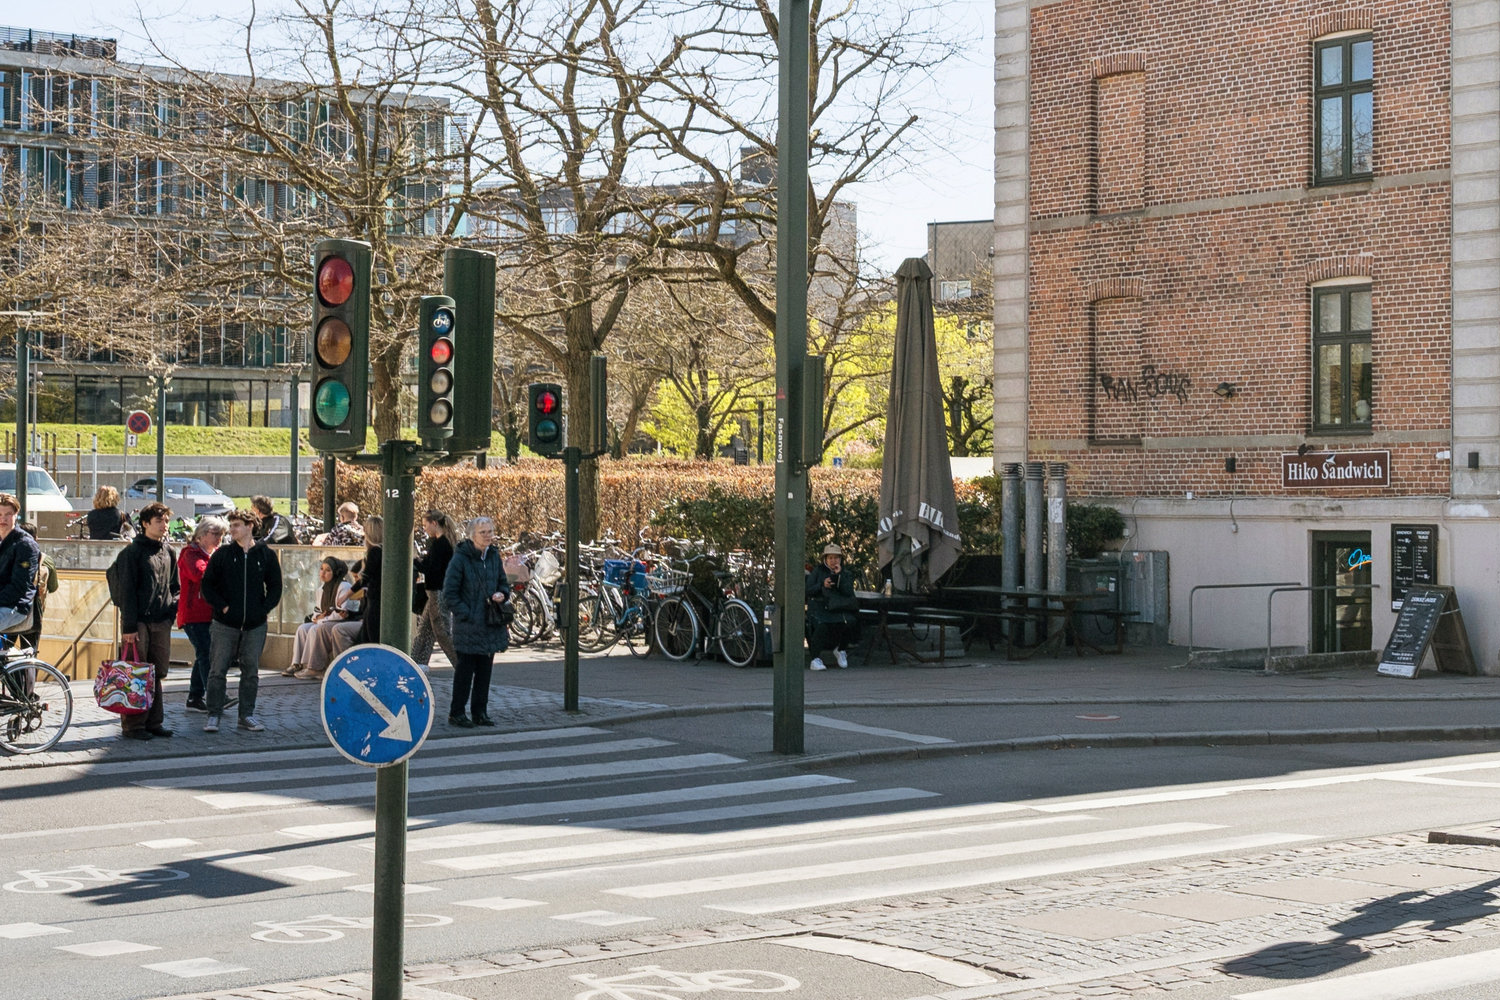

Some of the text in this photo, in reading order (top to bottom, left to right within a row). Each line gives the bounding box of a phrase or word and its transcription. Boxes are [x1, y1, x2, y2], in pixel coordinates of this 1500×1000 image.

[776, 417, 784, 463] Fasanvej
[1288, 460, 1383, 480] Hiko Sandwich
[385, 488, 400, 498] 12
